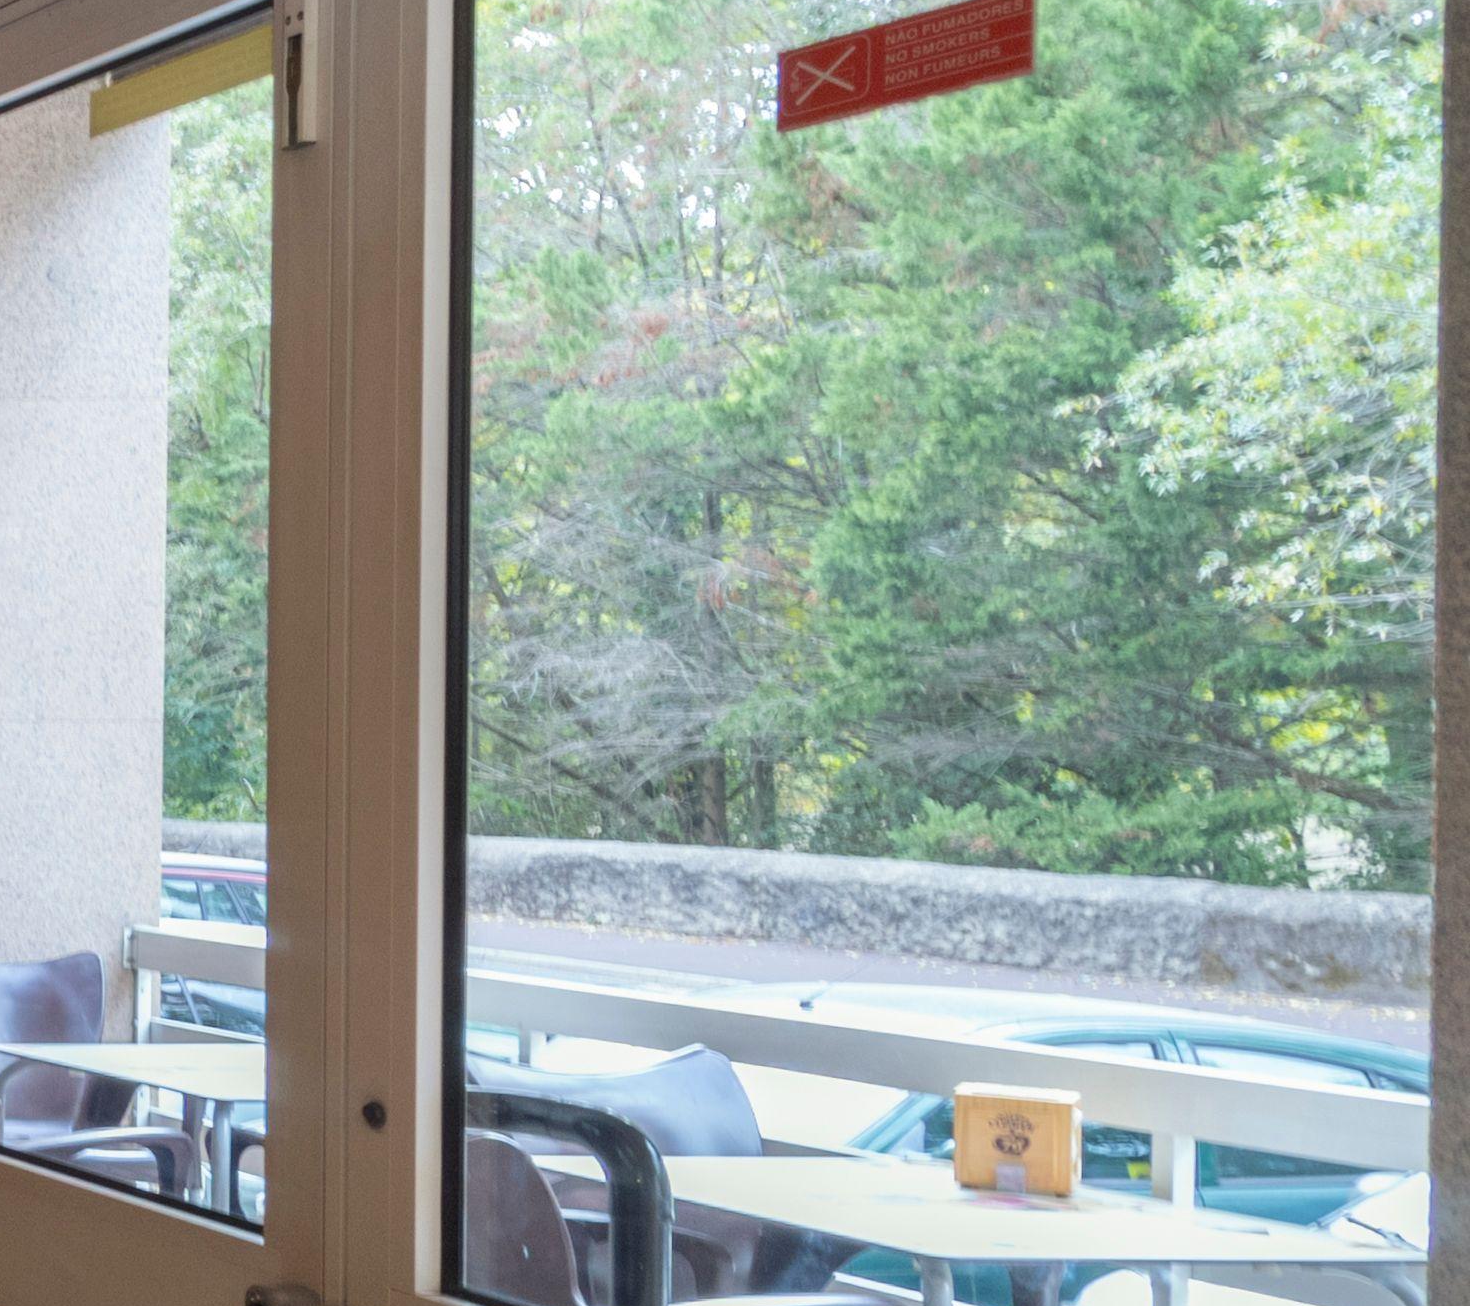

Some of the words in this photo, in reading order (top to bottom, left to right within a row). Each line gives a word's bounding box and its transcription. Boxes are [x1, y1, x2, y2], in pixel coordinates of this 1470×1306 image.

[885, 49, 907, 64] NO
[912, 28, 990, 58] SMOKERS
[885, 67, 918, 86] NON
[923, 46, 1001, 75] FUMEURS
